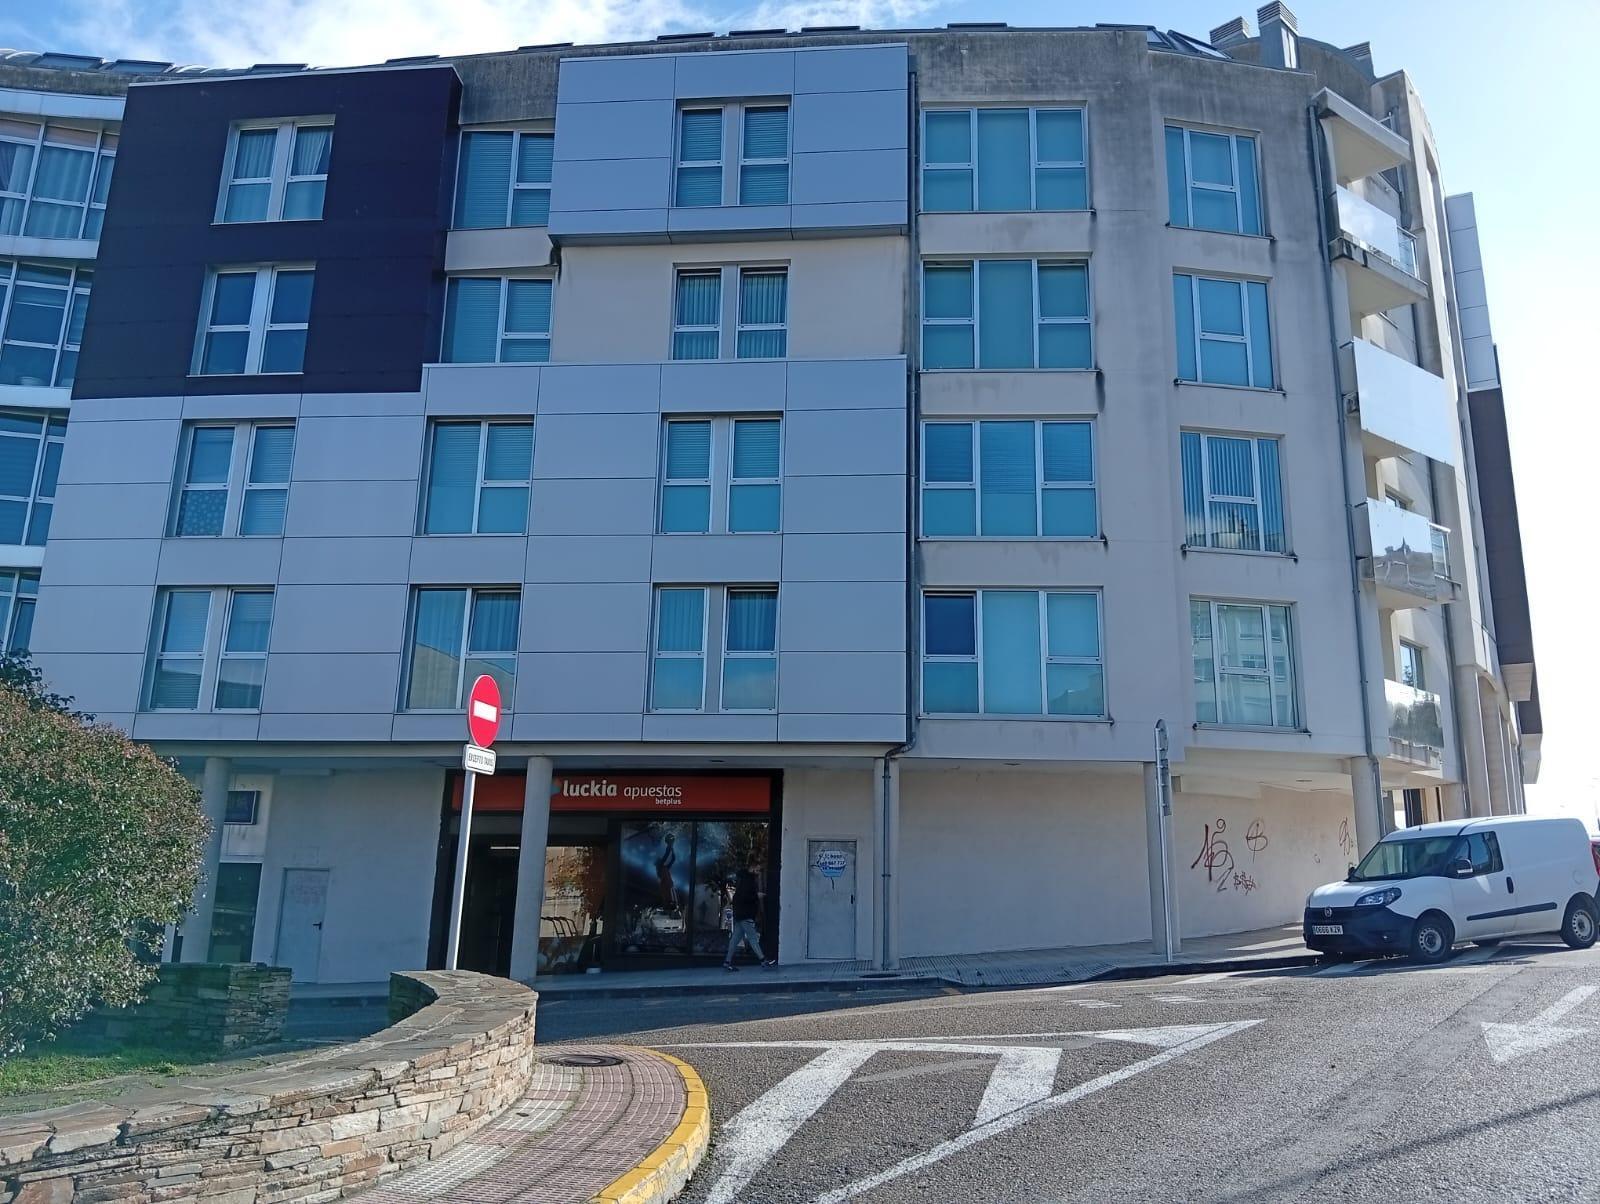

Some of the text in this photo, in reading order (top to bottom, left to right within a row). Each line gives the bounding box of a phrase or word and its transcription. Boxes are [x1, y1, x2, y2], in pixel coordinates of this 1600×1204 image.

[563, 779, 682, 800] luckia apuestas
[655, 797, 682, 806] betplus
